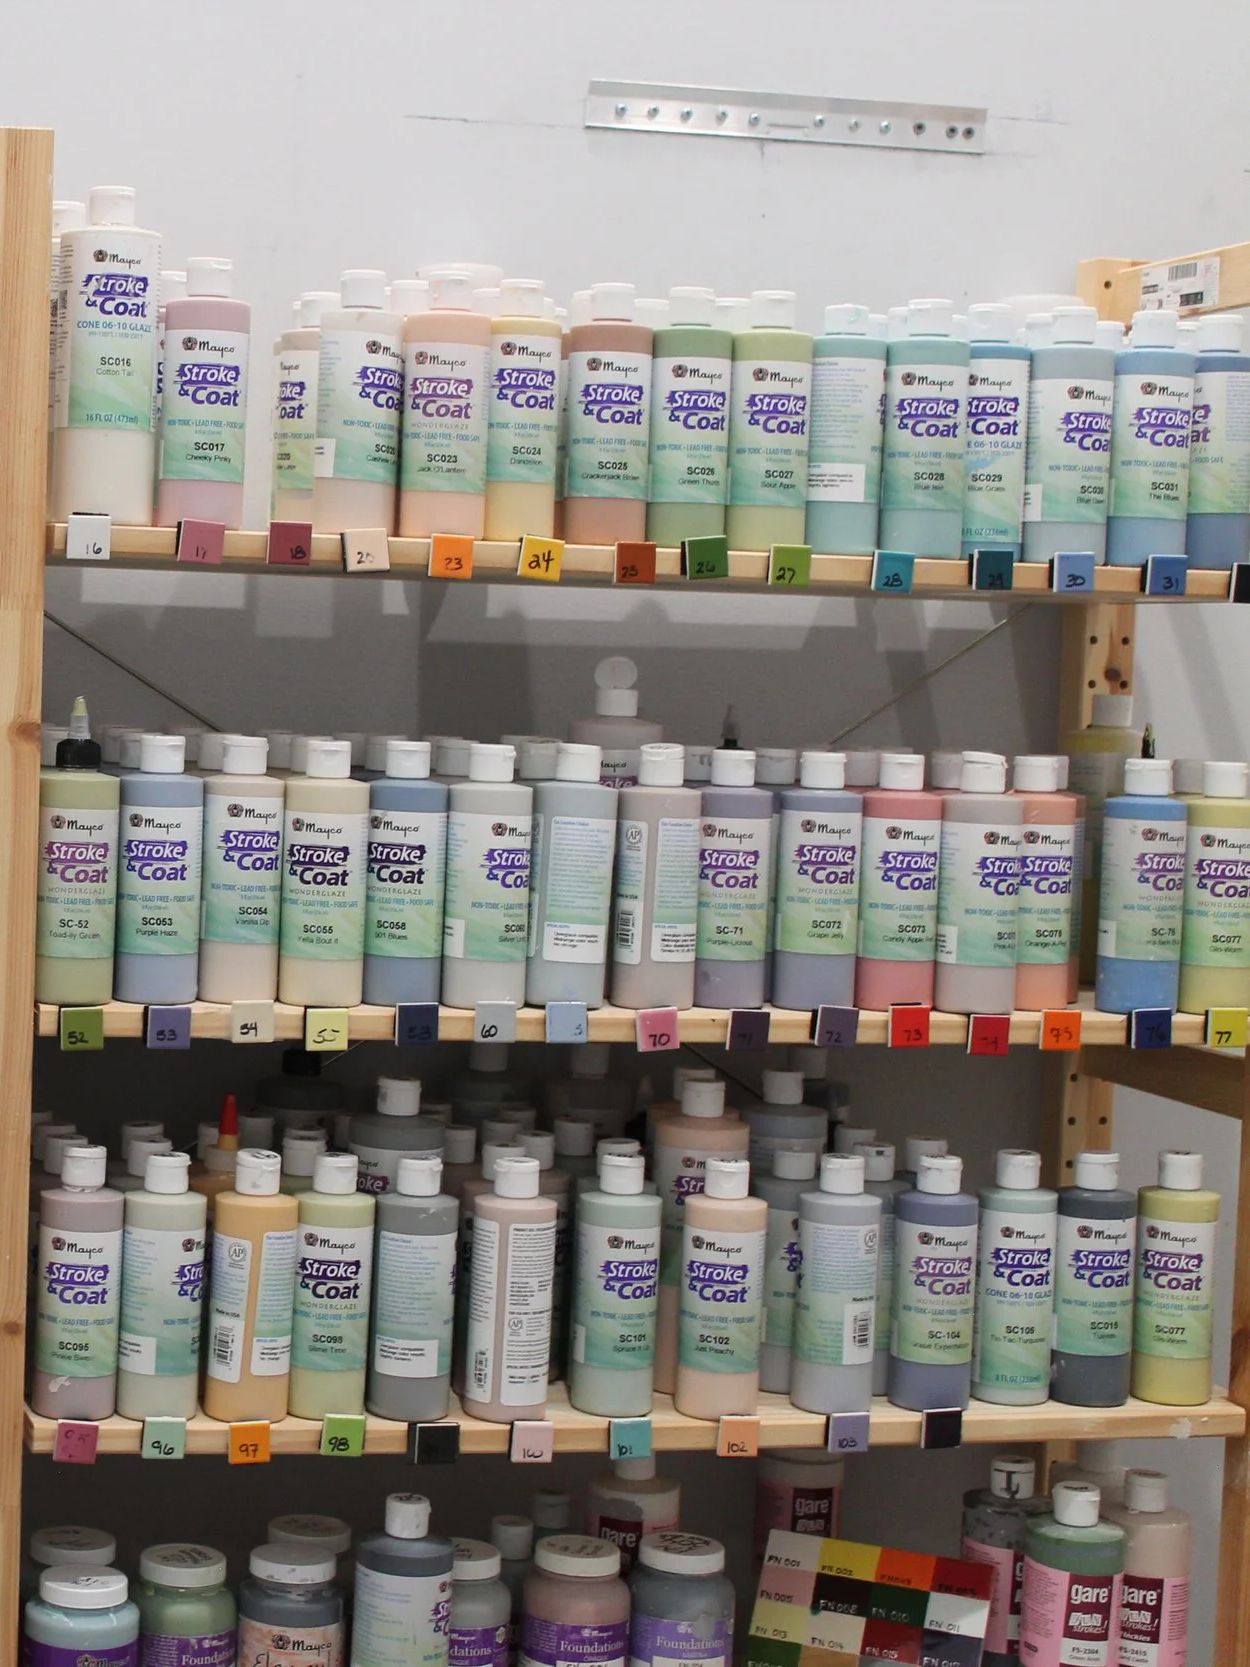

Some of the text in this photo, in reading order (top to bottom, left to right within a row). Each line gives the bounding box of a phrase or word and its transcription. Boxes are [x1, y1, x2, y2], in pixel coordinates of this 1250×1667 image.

[109, 253, 141, 269] Mayco
[100, 357, 131, 366] SC016
[183, 366, 236, 384] Stroke
[674, 393, 724, 410] Stroke
[904, 399, 956, 416] Stroke
[194, 442, 225, 452] SC017
[512, 446, 541, 456] SC024
[427, 454, 457, 464] SC023
[598, 461, 627, 470] SC025
[687, 467, 715, 476] SC026
[765, 470, 793, 480] SC027
[914, 472, 945, 482] SC028
[971, 473, 1002, 483] SC029
[1151, 482, 1178, 491] SC031
[85, 542, 102, 556] 16
[528, 550, 554, 570] 24
[776, 568, 795, 583] 27
[717, 829, 753, 844] Mayco
[293, 847, 343, 862] Stroke
[703, 852, 754, 867] Stroke
[886, 854, 935, 869] Stroke
[239, 907, 267, 916] SC054
[59, 919, 89, 929] SC-52
[142, 917, 173, 927] SC053
[377, 920, 406, 930] SC058
[812, 920, 841, 929] SC072
[303, 924, 333, 934] SC055
[716, 926, 743, 935] SC-71
[898, 924, 925, 934] SC073
[1212, 935, 1241, 944] SC077
[240, 1022, 258, 1036] 54
[481, 1024, 498, 1038] 60
[68, 1031, 89, 1044] 52
[156, 1029, 177, 1042] 53
[649, 1034, 670, 1046] 70
[1216, 1032, 1232, 1044] 77
[304, 1262, 356, 1278] Stroke
[301, 1279, 359, 1299] & Coat
[1006, 1325, 1034, 1334] SC105
[1090, 1321, 1118, 1330] SC015
[1155, 1325, 1185, 1334] SC077
[313, 1334, 343, 1343] SC098
[619, 1334, 646, 1343] SC101
[699, 1335, 729, 1344] SC102
[928, 1331, 960, 1339] SC-104
[59, 1341, 89, 1351] SC095
[152, 1442, 174, 1455] 96
[328, 1438, 349, 1451] 98
[727, 1442, 748, 1453] 102
[239, 1444, 259, 1457] 97
[795, 1498, 830, 1515] gare
[601, 1527, 636, 1548] gare
[1070, 1586, 1109, 1604] gare
[292, 1639, 332, 1655] Mayco
[560, 1641, 623, 1652] Foundations
[657, 1637, 723, 1648] Foundations
